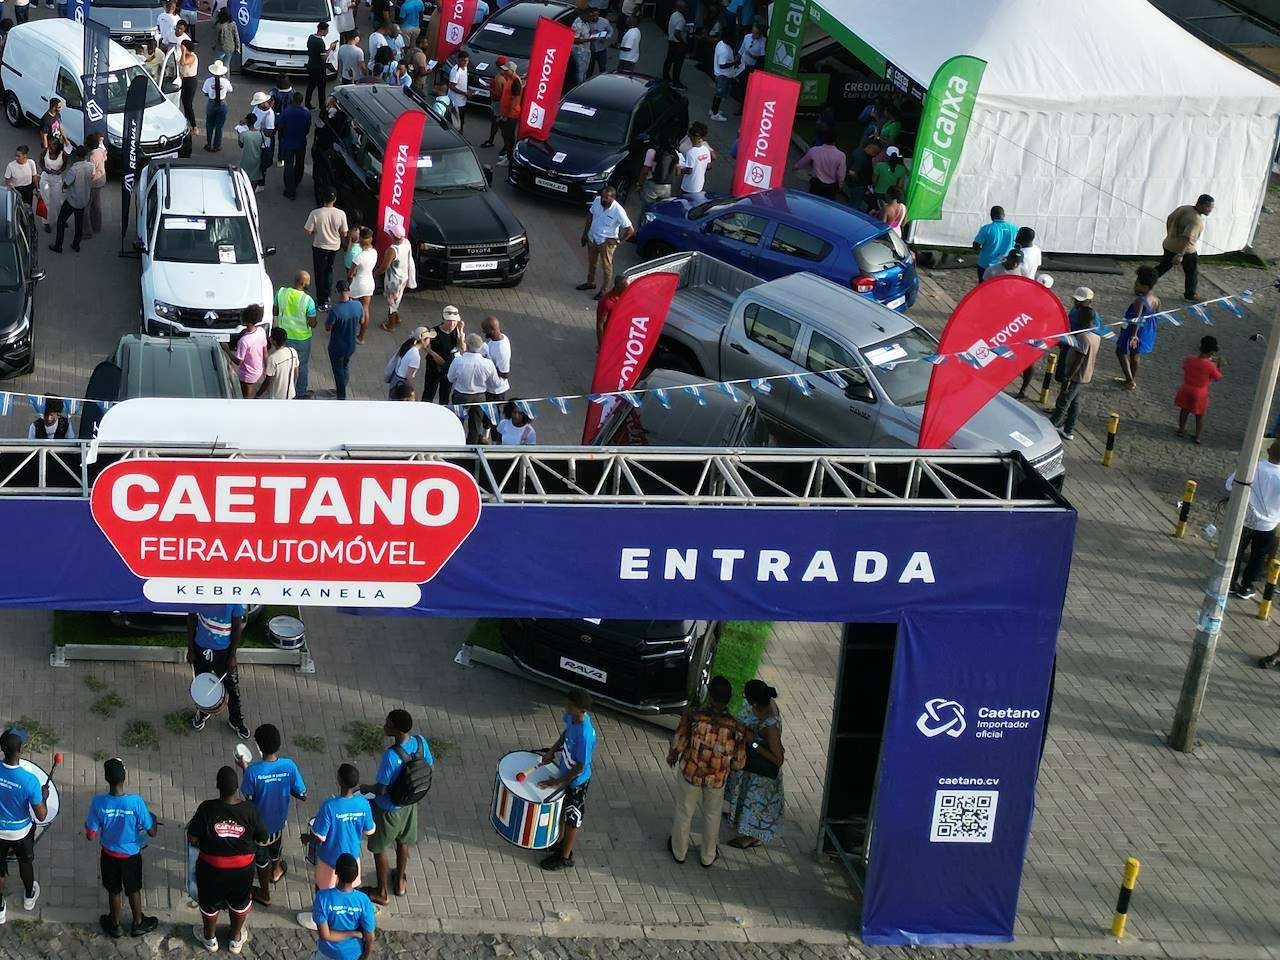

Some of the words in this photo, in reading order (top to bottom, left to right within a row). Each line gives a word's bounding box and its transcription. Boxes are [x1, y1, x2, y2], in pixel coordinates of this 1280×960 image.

[91, 46, 99, 96] RENAULT
[537, 48, 557, 100] TOYOTA
[754, 100, 777, 158] TOYOTA
[933, 76, 969, 149] caixa
[129, 119, 137, 170] RENAULT
[391, 144, 409, 205] TOYOTA
[989, 313, 1033, 347] TOYOTA
[111, 473, 460, 527] CAETANO
[140, 537, 228, 562] FEIRA
[234, 535, 426, 566] AUTOMÓVEL
[619, 547, 937, 584] ENTRADA
[177, 585, 261, 597] KEBRA
[282, 586, 386, 600] KANELA
[564, 661, 603, 679] RAV4
[978, 707, 1040, 719] Caetano
[975, 730, 1004, 738] oficial
[938, 777, 1000, 785] caetano.cv
